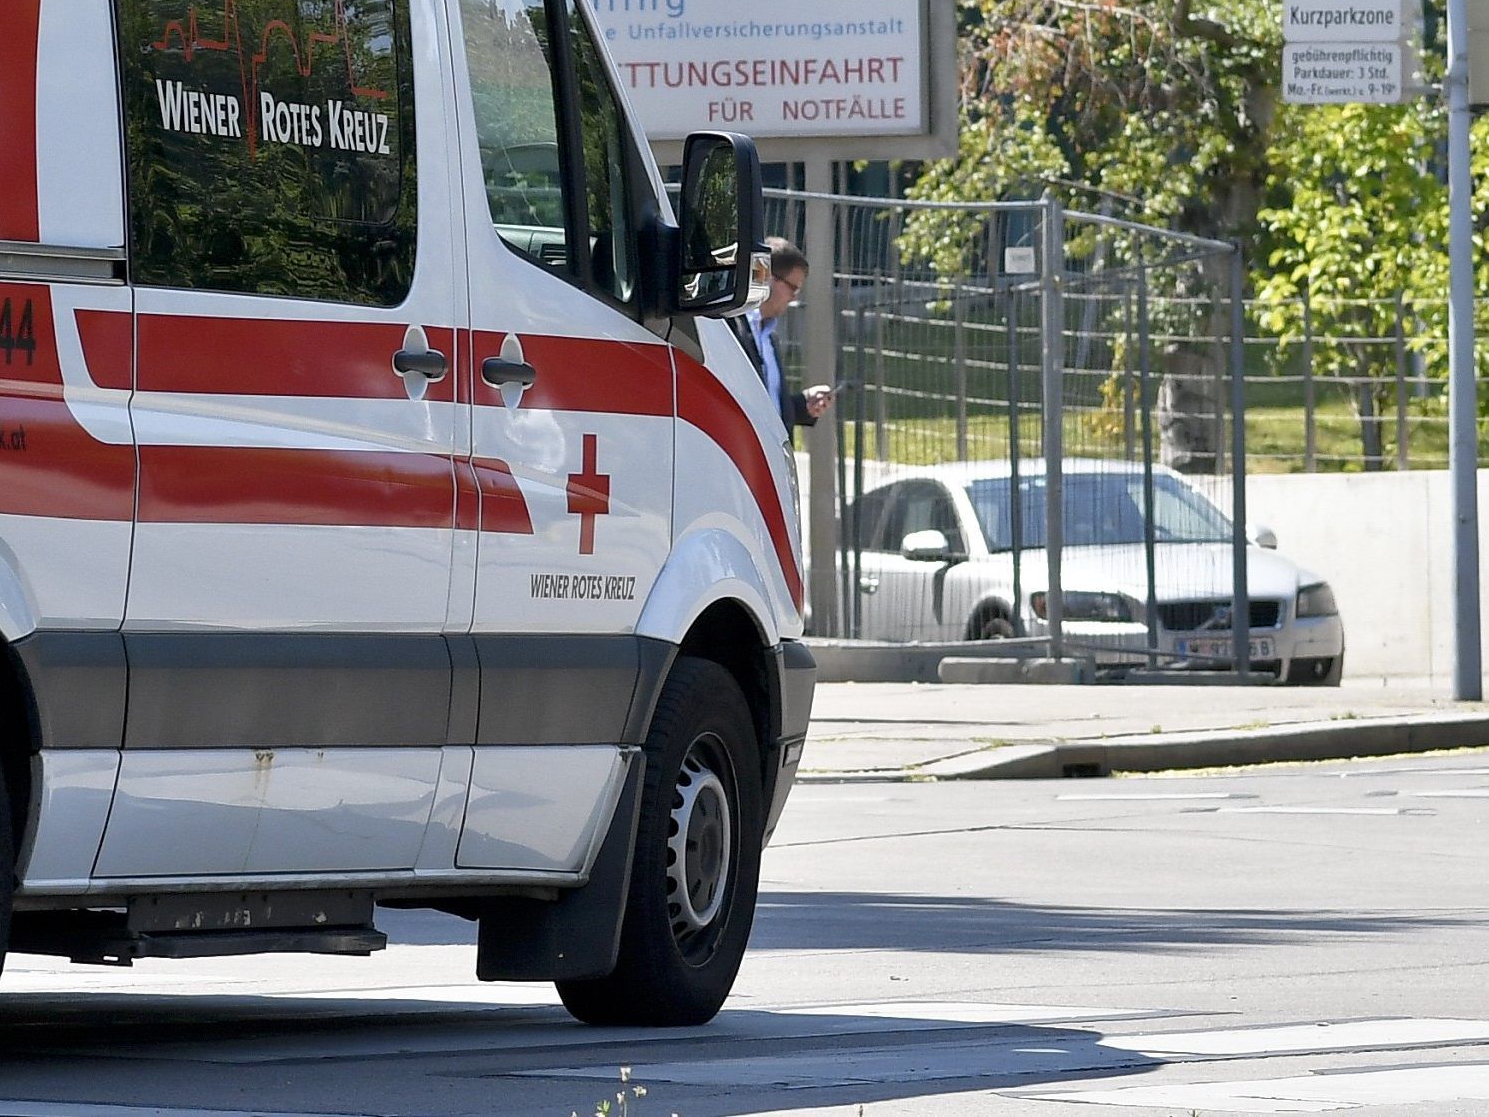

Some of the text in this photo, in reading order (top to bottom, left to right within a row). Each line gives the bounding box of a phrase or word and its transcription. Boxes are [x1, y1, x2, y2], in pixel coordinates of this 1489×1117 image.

[630, 18, 904, 40] Unfallversicherungsanstalt
[1290, 6, 1394, 28] Kurzparkzone
[1292, 48, 1393, 64] gebührenpflichtig
[618, 57, 904, 89] TTUNGSEINFAHRT
[1294, 66, 1389, 80] Parkdauer: 3 Std.
[156, 79, 391, 155] WIENER ROTES KREUZ
[708, 96, 906, 123] FÜR NOTFÄLLE
[530, 573, 636, 601] WIENER ROTES KREUZ
